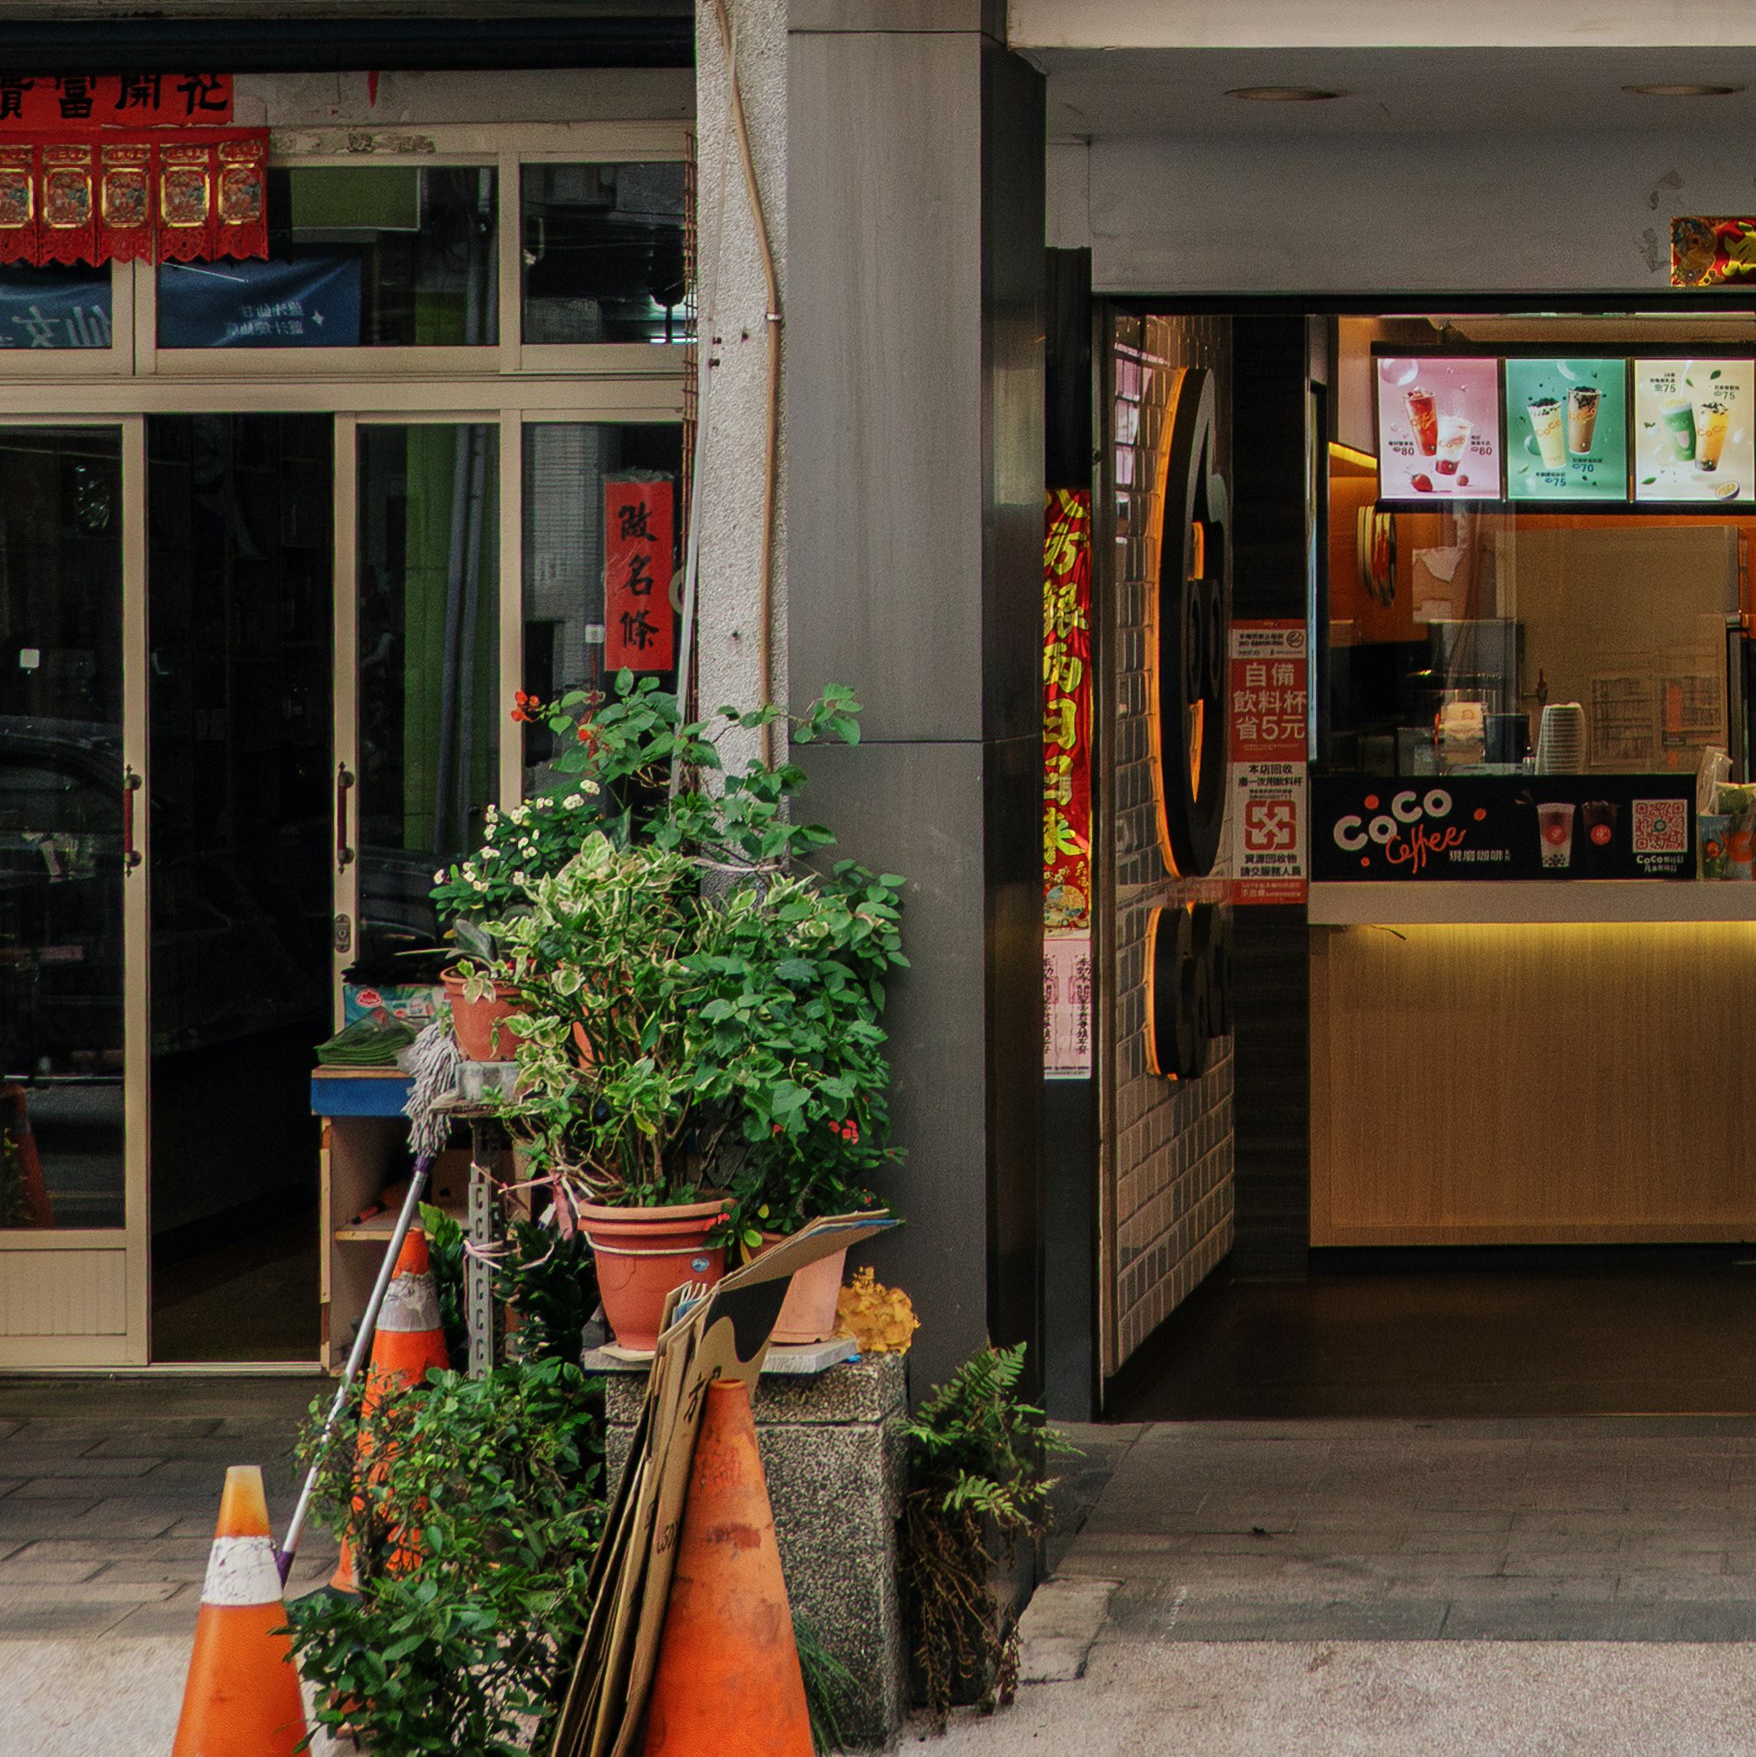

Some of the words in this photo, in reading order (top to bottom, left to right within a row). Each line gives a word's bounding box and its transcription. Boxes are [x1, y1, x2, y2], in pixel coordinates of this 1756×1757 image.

[1661, 384, 1676, 393] 75
[1722, 390, 1736, 400] 75
[1400, 446, 1415, 456] 80
[1479, 446, 1493, 456] 80
[1580, 463, 1594, 473] 70
[1552, 478, 1567, 487] 75
[1245, 661, 1295, 688] 自備
[1233, 689, 1307, 714] 飲料杯
[1236, 715, 1306, 740] 省5元
[1248, 763, 1293, 774] 本店回收
[1333, 788, 1453, 852] CoCo
[1385, 822, 1467, 875] Coffee
[1244, 853, 1298, 865] 資源回收物
